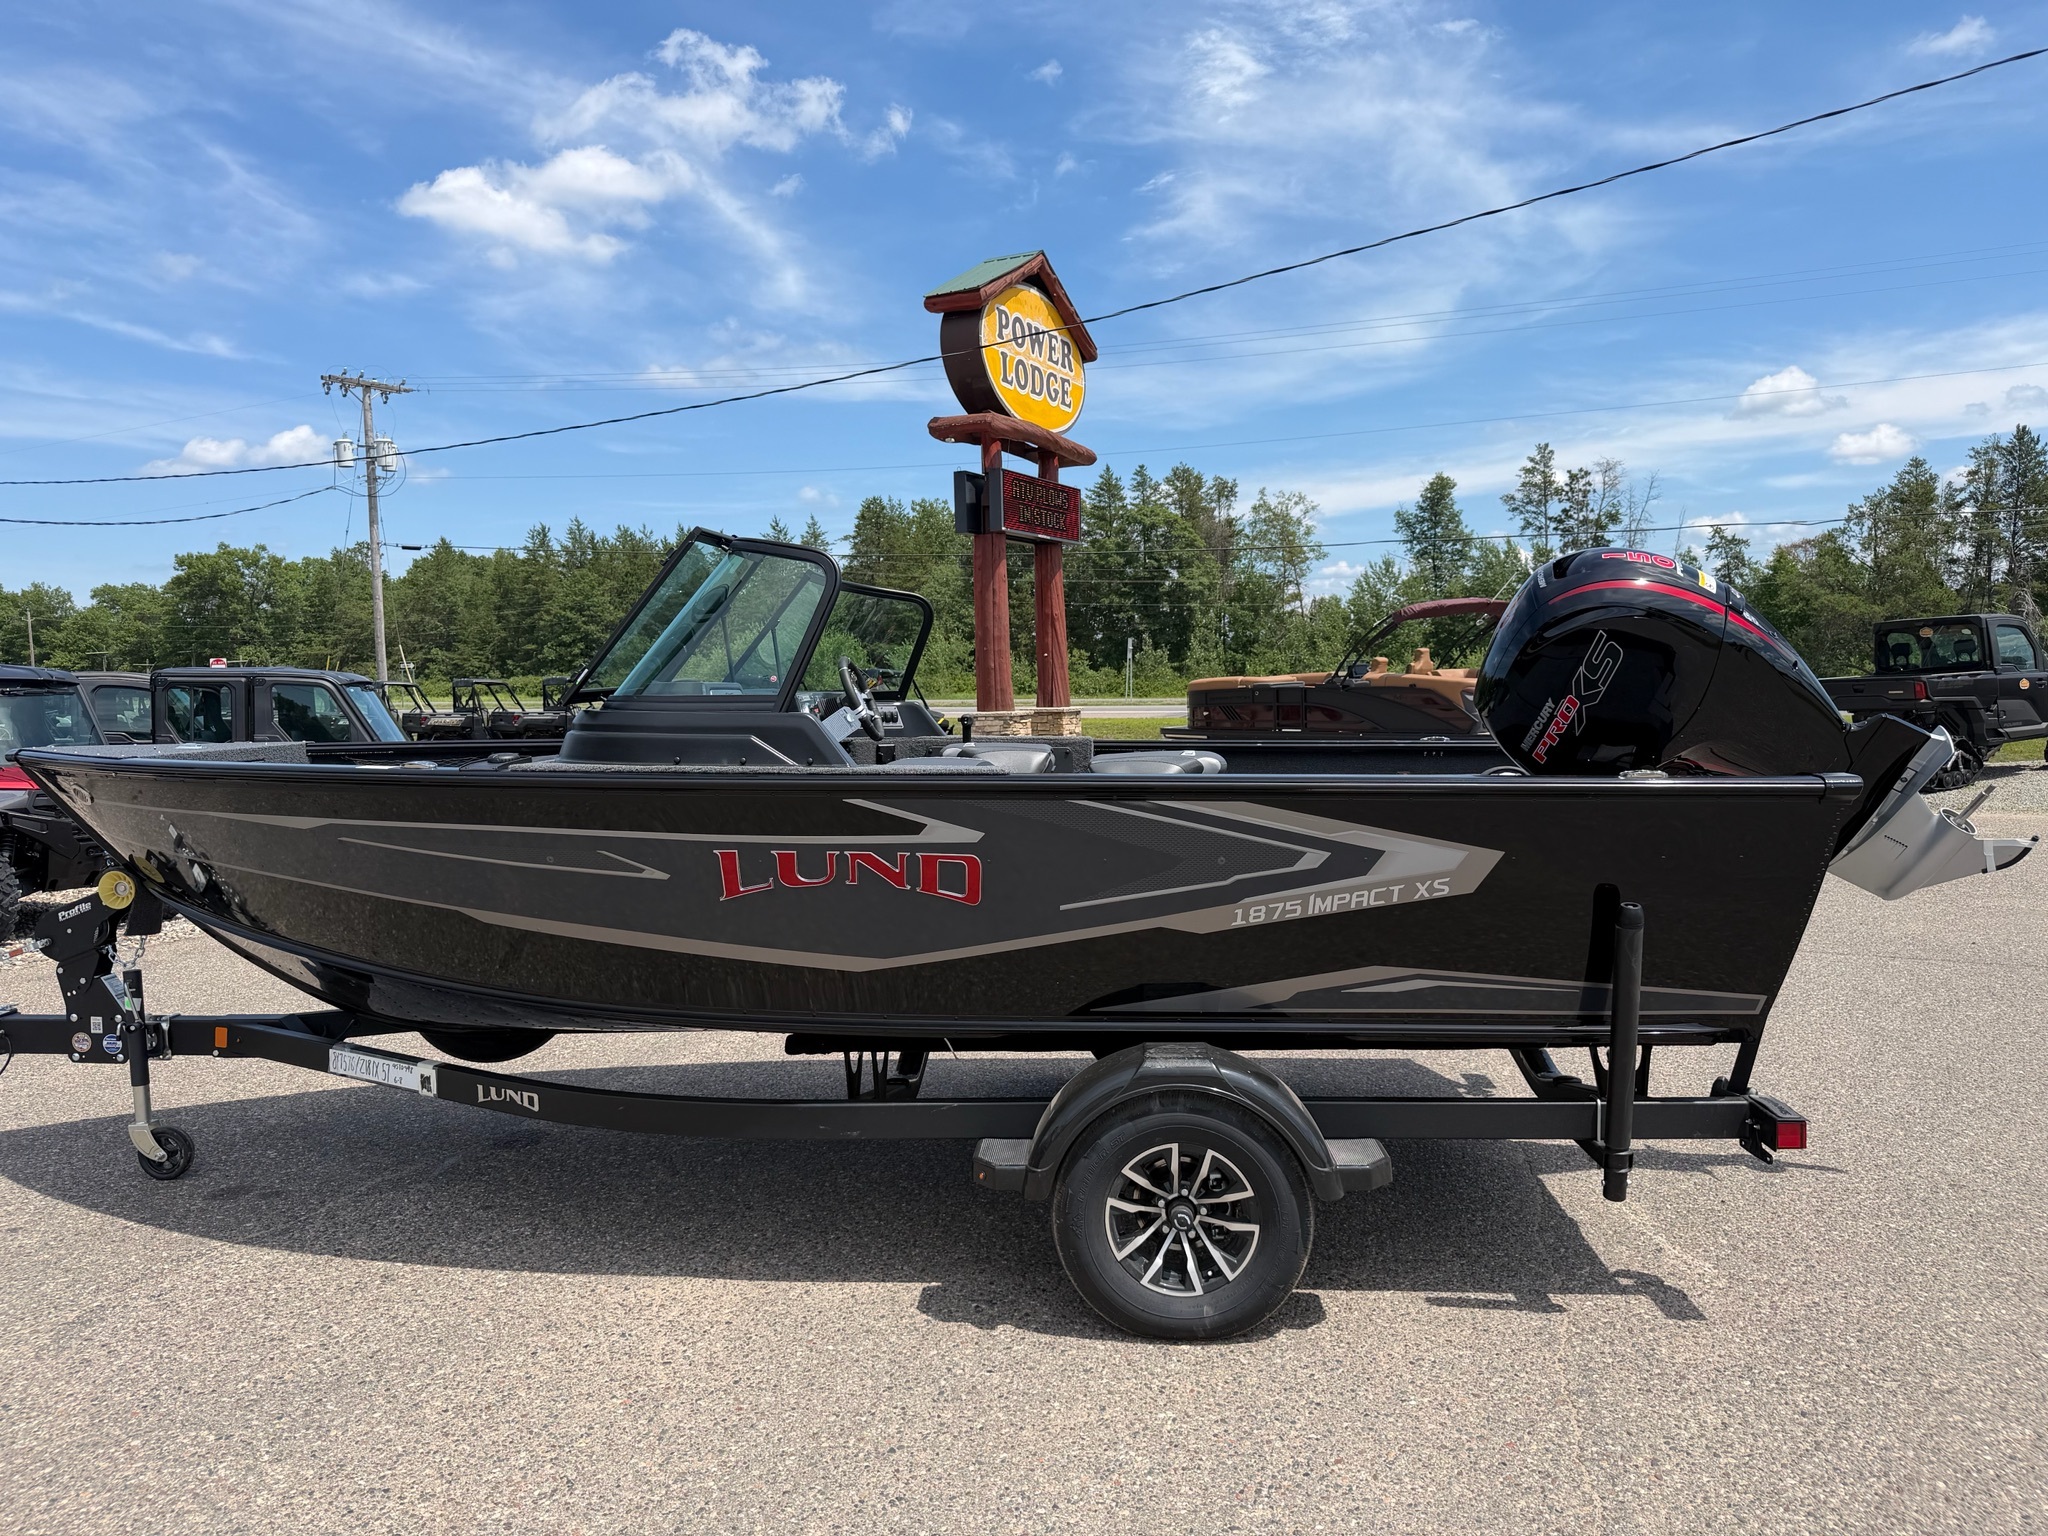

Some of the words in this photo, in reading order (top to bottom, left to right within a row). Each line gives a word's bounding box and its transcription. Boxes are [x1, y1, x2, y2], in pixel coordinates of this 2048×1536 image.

[996, 306, 1074, 373] POWER
[1000, 351, 1072, 409] LODGE
[1602, 551, 1676, 570] 150
[1532, 694, 1580, 764] PRO
[1572, 629, 1624, 737] XS
[1520, 697, 1556, 752] MERCURY
[714, 850, 982, 906] LUND
[1231, 899, 1302, 926] 1875
[1307, 884, 1405, 915] IMPACT
[1413, 877, 1451, 900] XS
[58, 902, 92, 921] Profile
[476, 1084, 540, 1112] LUND
